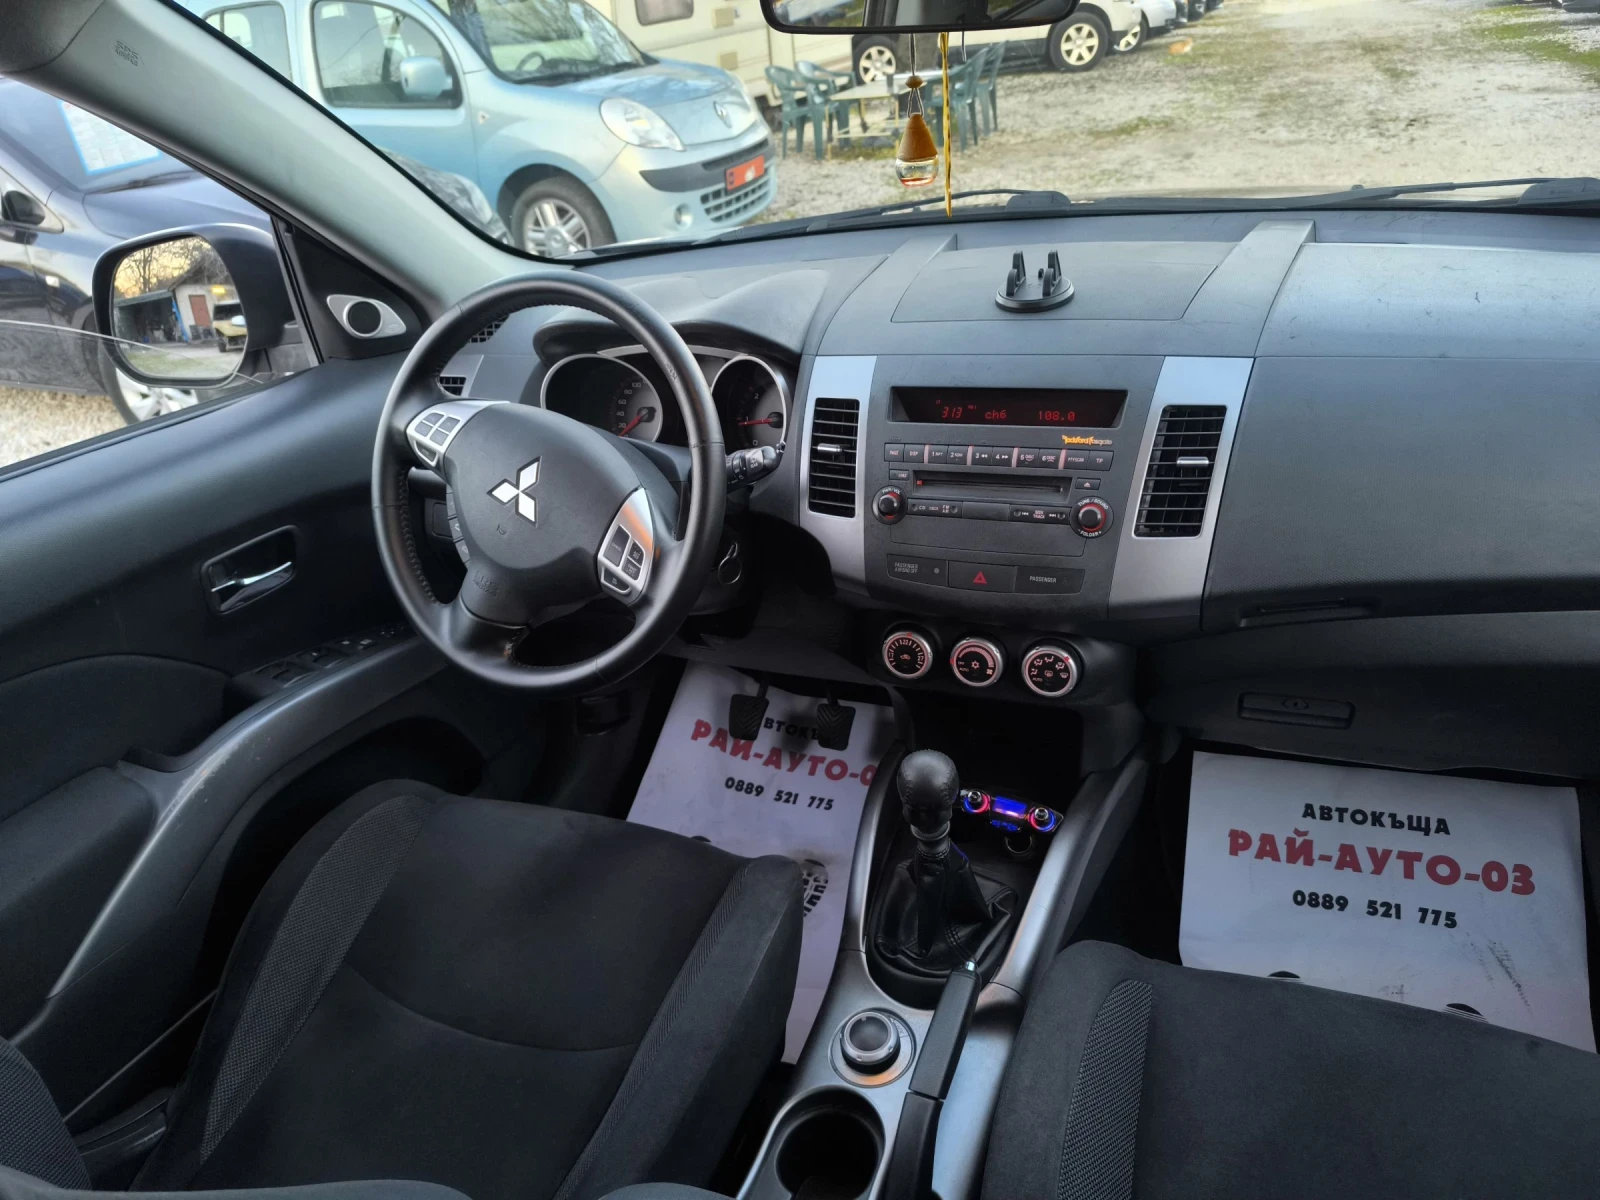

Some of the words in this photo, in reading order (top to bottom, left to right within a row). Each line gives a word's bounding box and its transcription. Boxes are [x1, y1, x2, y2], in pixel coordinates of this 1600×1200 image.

[942, 406, 963, 419] 313
[985, 409, 1007, 420] ch6
[1039, 410, 1075, 421] 108.0
[725, 777, 764, 797] 0889
[773, 790, 799, 805] 521
[807, 795, 834, 811] 775
[1302, 802, 1451, 836] АВТОКЪЩА
[1227, 827, 1536, 896] РАЙ-АУТО-03
[1292, 889, 1349, 912] 0889
[1366, 899, 1402, 920] 521
[1417, 907, 1458, 929] 775
